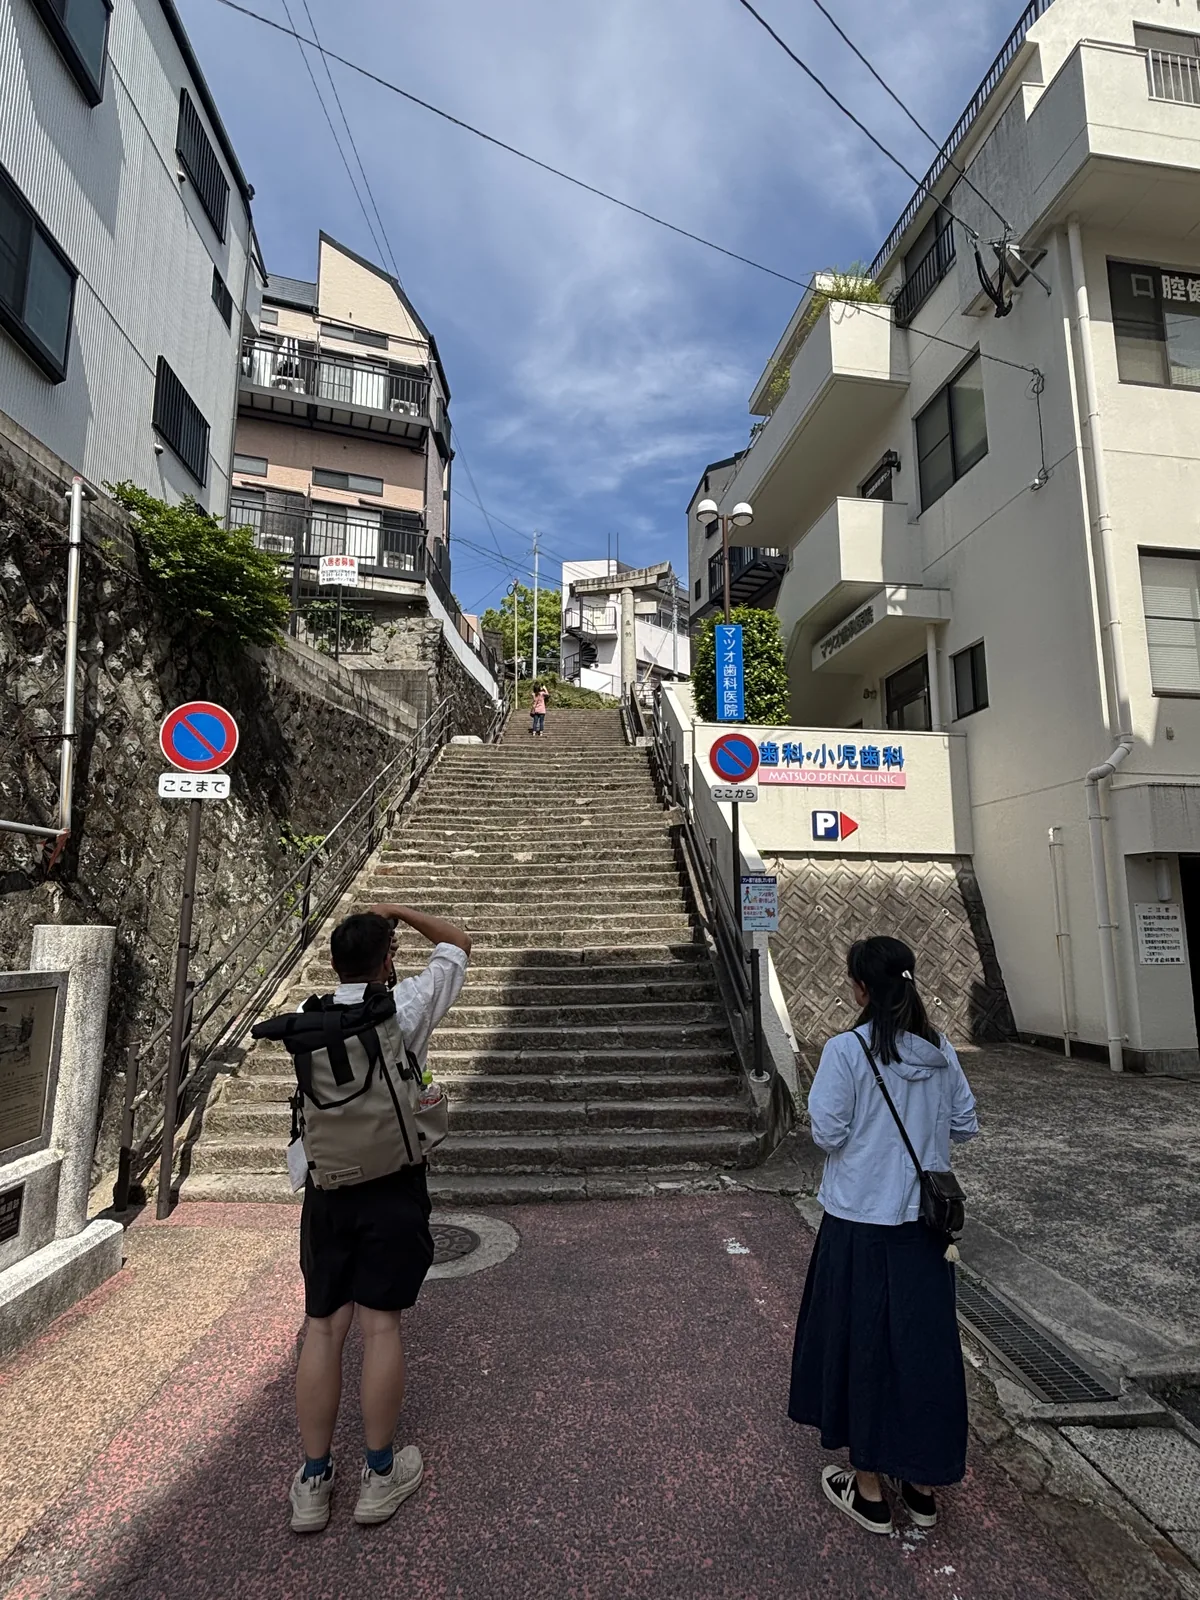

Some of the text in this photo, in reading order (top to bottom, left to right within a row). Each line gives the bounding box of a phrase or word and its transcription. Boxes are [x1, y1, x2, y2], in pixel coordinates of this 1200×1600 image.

[321, 557, 355, 567] 入居者募集
[819, 605, 874, 659] マツオ歯科医院
[723, 627, 739, 717] マツオ歯科医院
[759, 740, 905, 771] 歯科・小児歯科
[163, 779, 226, 793] ここまで
[768, 771, 897, 785] MATSUO DENTAL CLINIC
[714, 788, 755, 799] ここから
[816, 812, 836, 836] P
